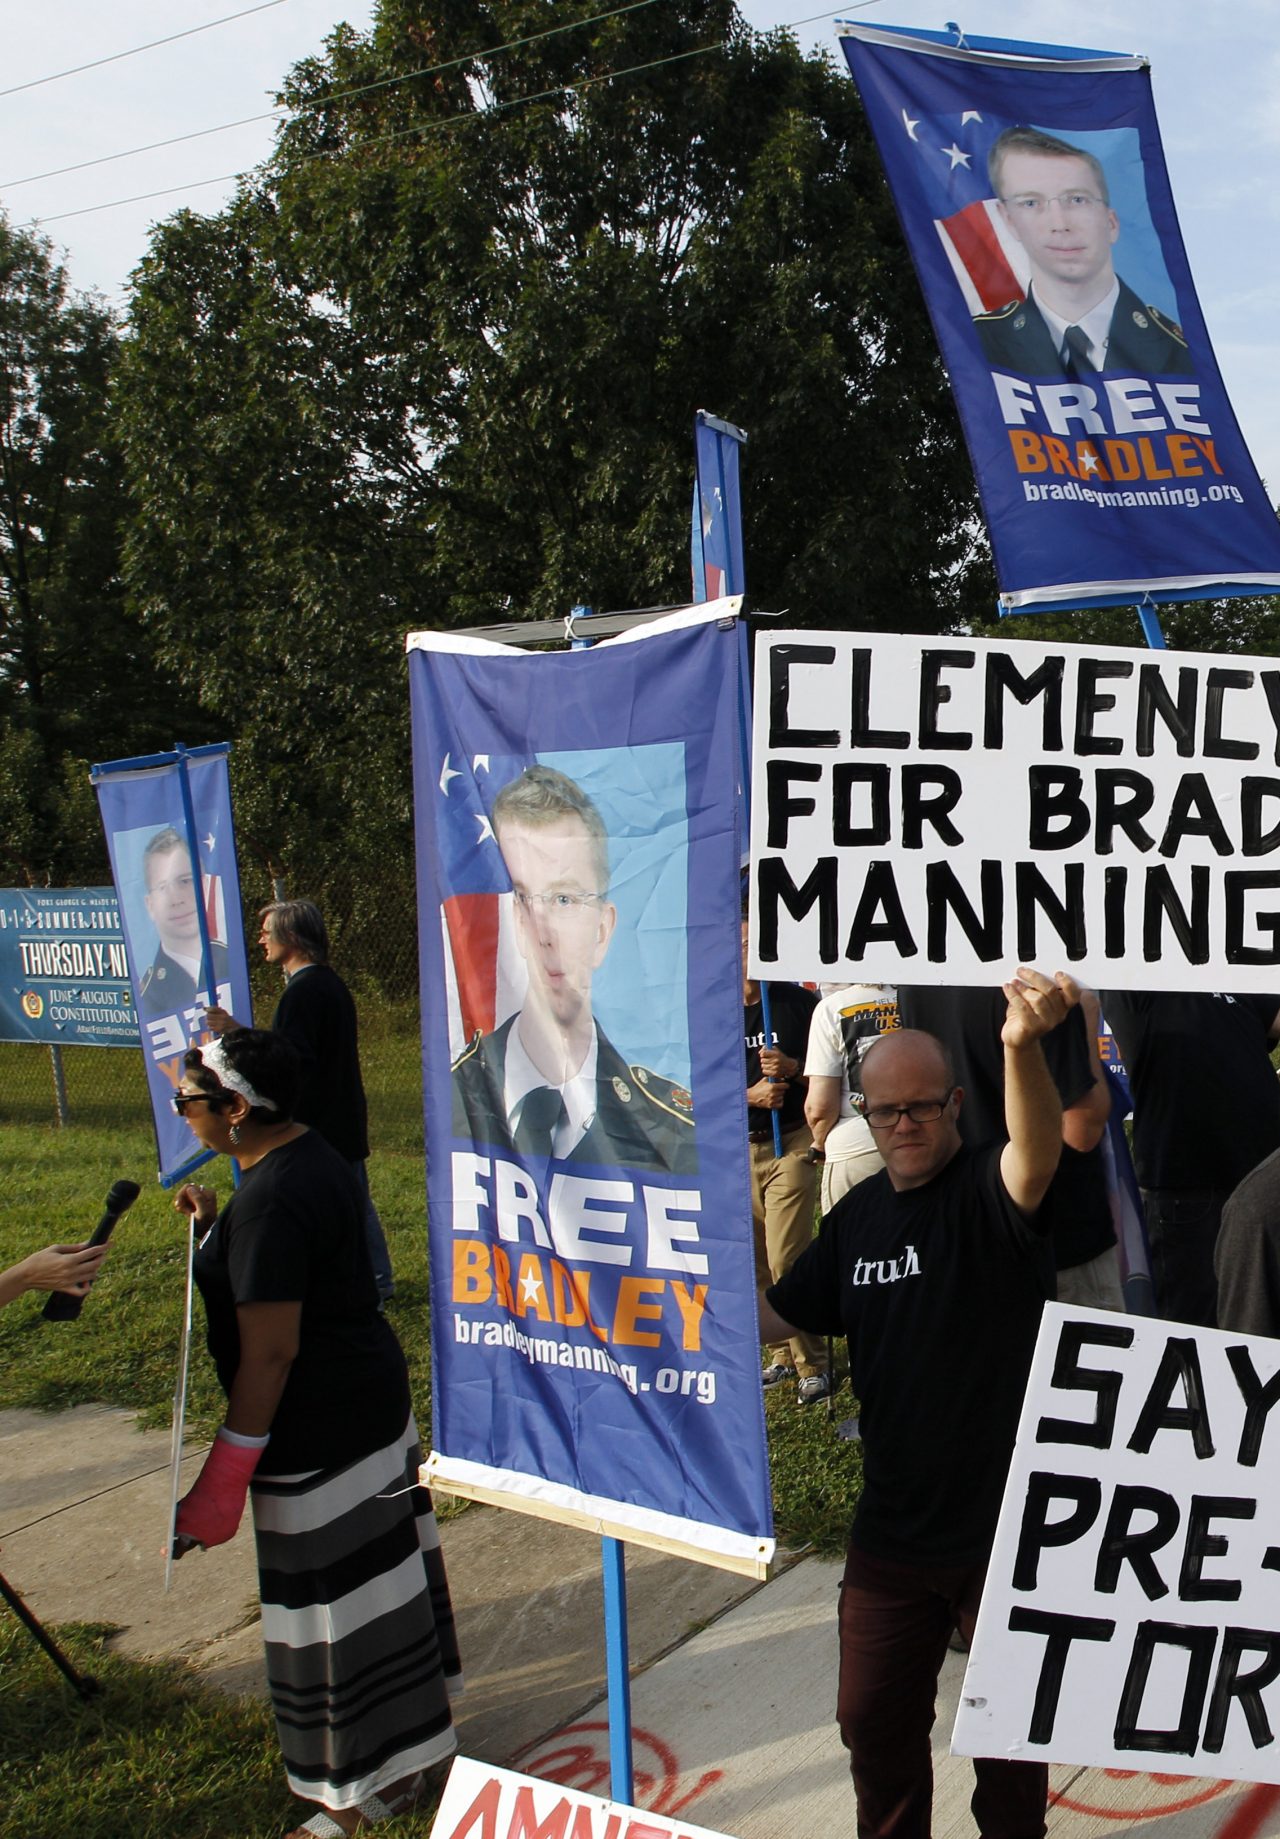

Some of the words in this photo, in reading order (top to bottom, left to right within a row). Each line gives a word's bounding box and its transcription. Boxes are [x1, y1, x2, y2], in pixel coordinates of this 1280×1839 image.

[990, 371, 1211, 436] FREE
[1008, 429, 1224, 482] BRADLEY
[1022, 480, 1244, 508] bradleymanning.org
[766, 760, 964, 849] FOR
[19, 943, 104, 976] THURSDAY
[50, 989, 73, 1004] JUNE
[81, 991, 118, 1006] AUGUST
[50, 1006, 131, 1023] CONSTITUTION
[451, 1152, 709, 1275] FREE
[452, 1239, 709, 1351] BRADLEY
[454, 1313, 716, 1404] bradleymanning.org
